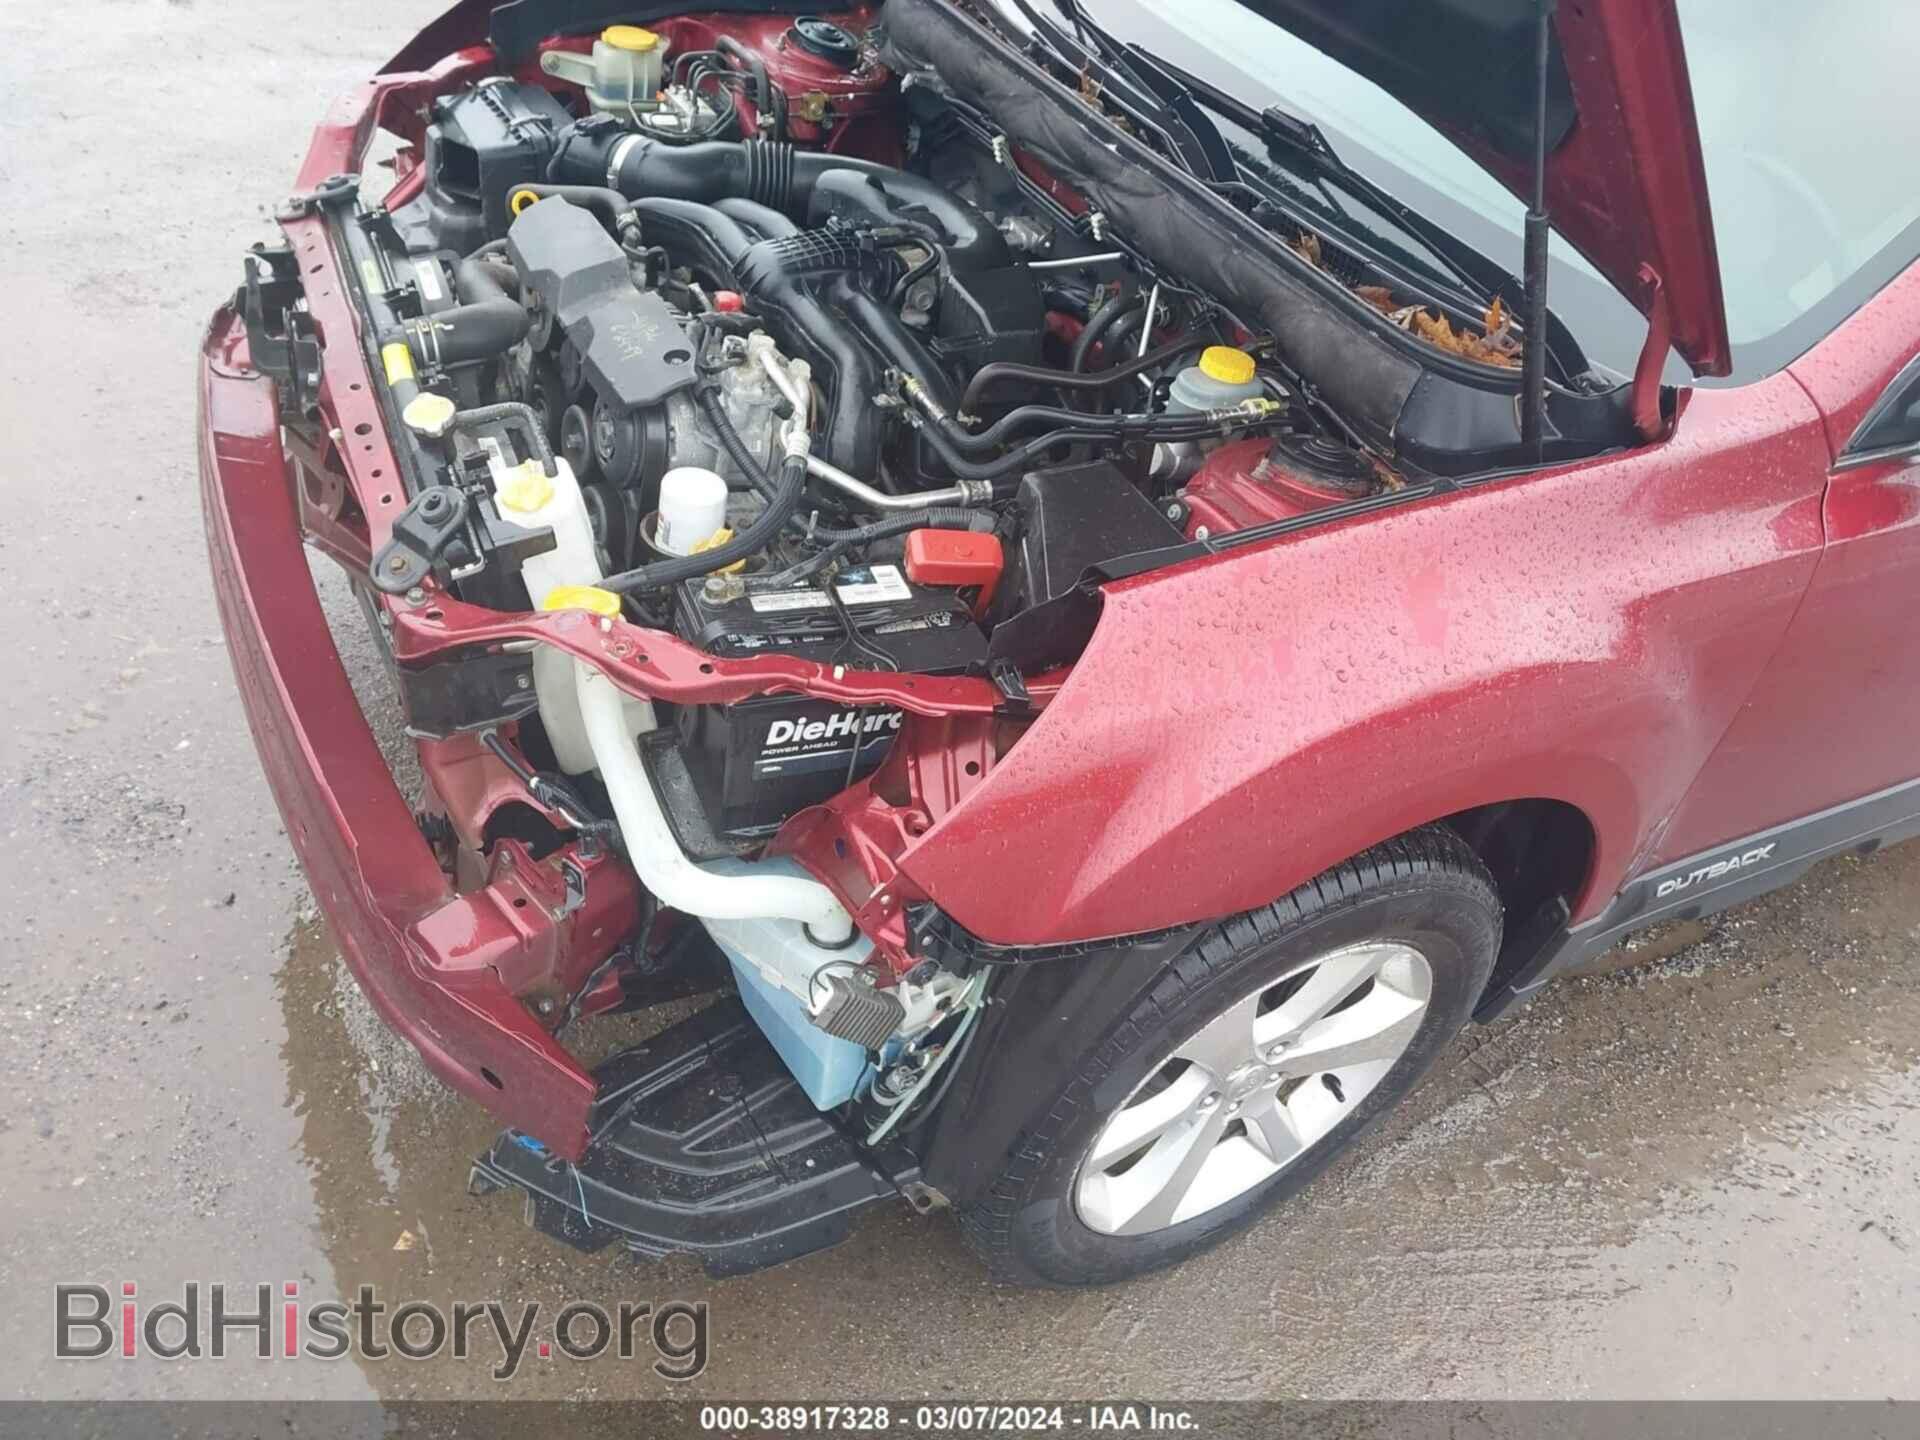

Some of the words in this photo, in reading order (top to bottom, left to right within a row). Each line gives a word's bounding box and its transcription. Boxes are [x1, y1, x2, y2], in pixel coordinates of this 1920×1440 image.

[761, 745, 799, 755] POWER
[802, 741, 838, 750] AHEAD
[1656, 842, 1776, 898] OUTBACK
